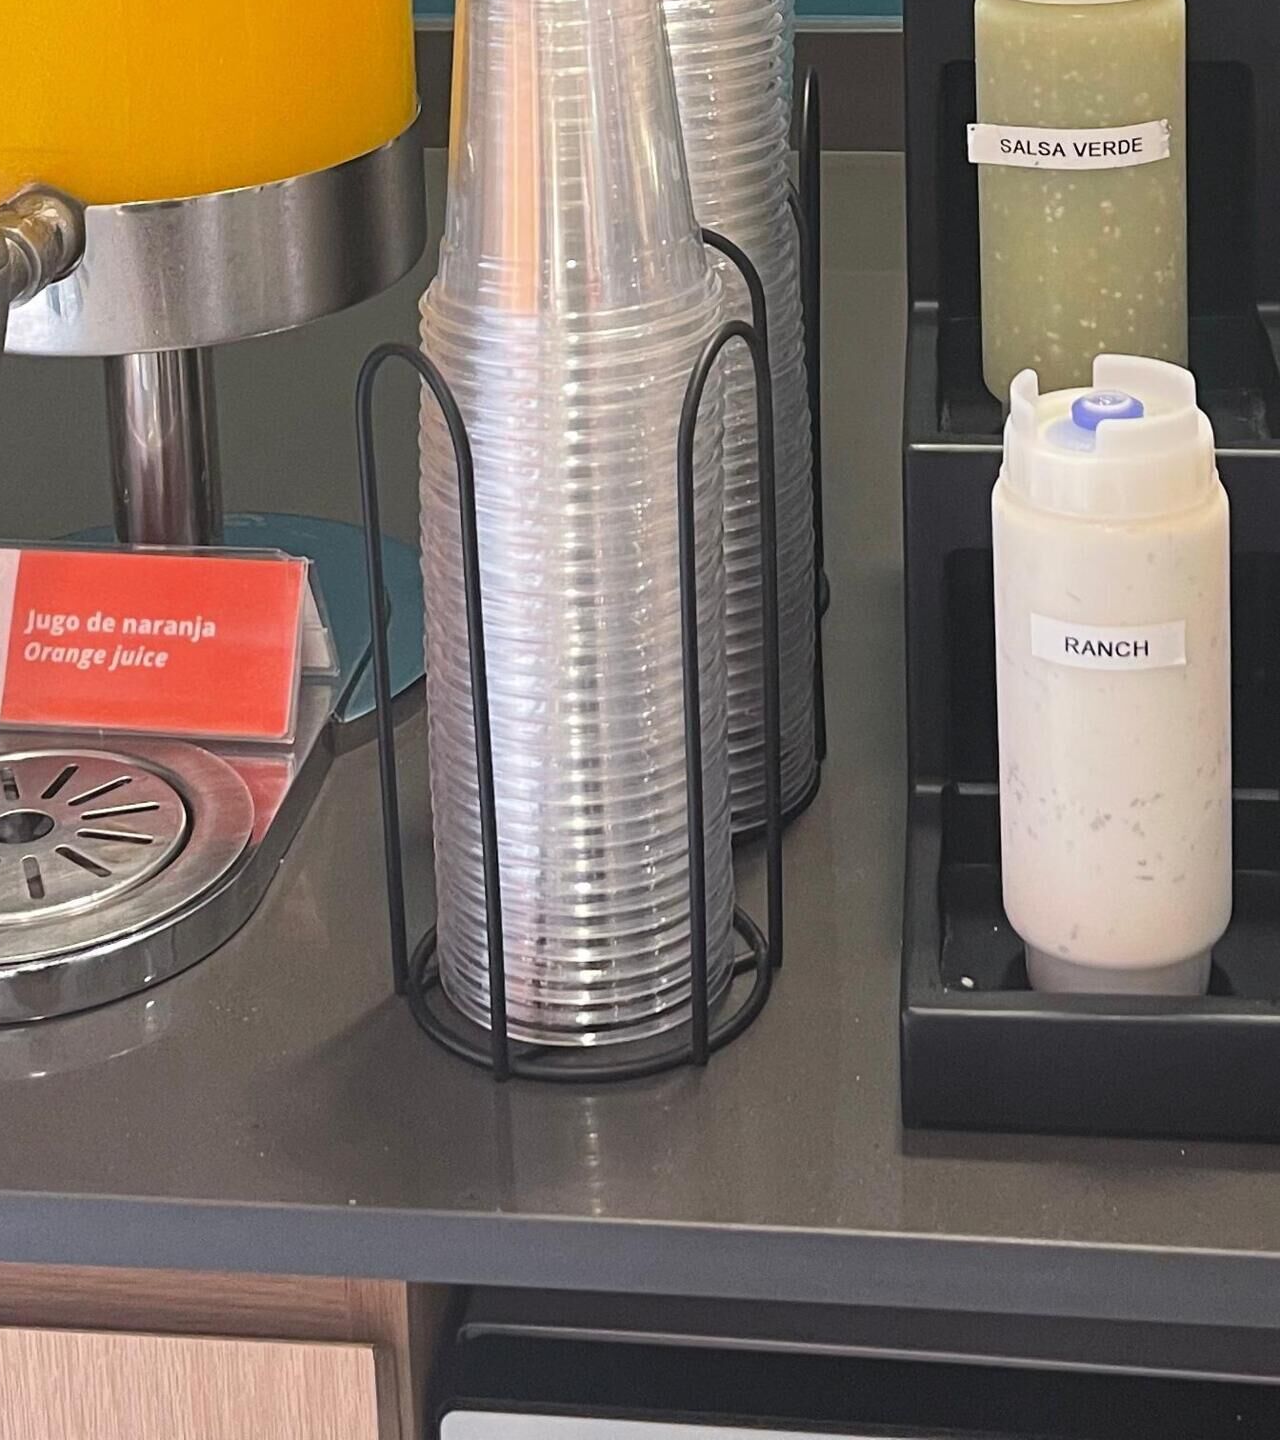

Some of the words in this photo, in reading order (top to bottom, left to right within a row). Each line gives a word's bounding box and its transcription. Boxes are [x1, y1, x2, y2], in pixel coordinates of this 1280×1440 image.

[1000, 138, 1066, 157] SALSA
[1072, 137, 1143, 157] VERDE
[23, 609, 80, 636] Jugo
[86, 611, 116, 633] de
[122, 615, 216, 643] naranja
[23, 642, 107, 670] Orange
[108, 644, 169, 671] juice
[1065, 636, 1149, 657] RANCH
